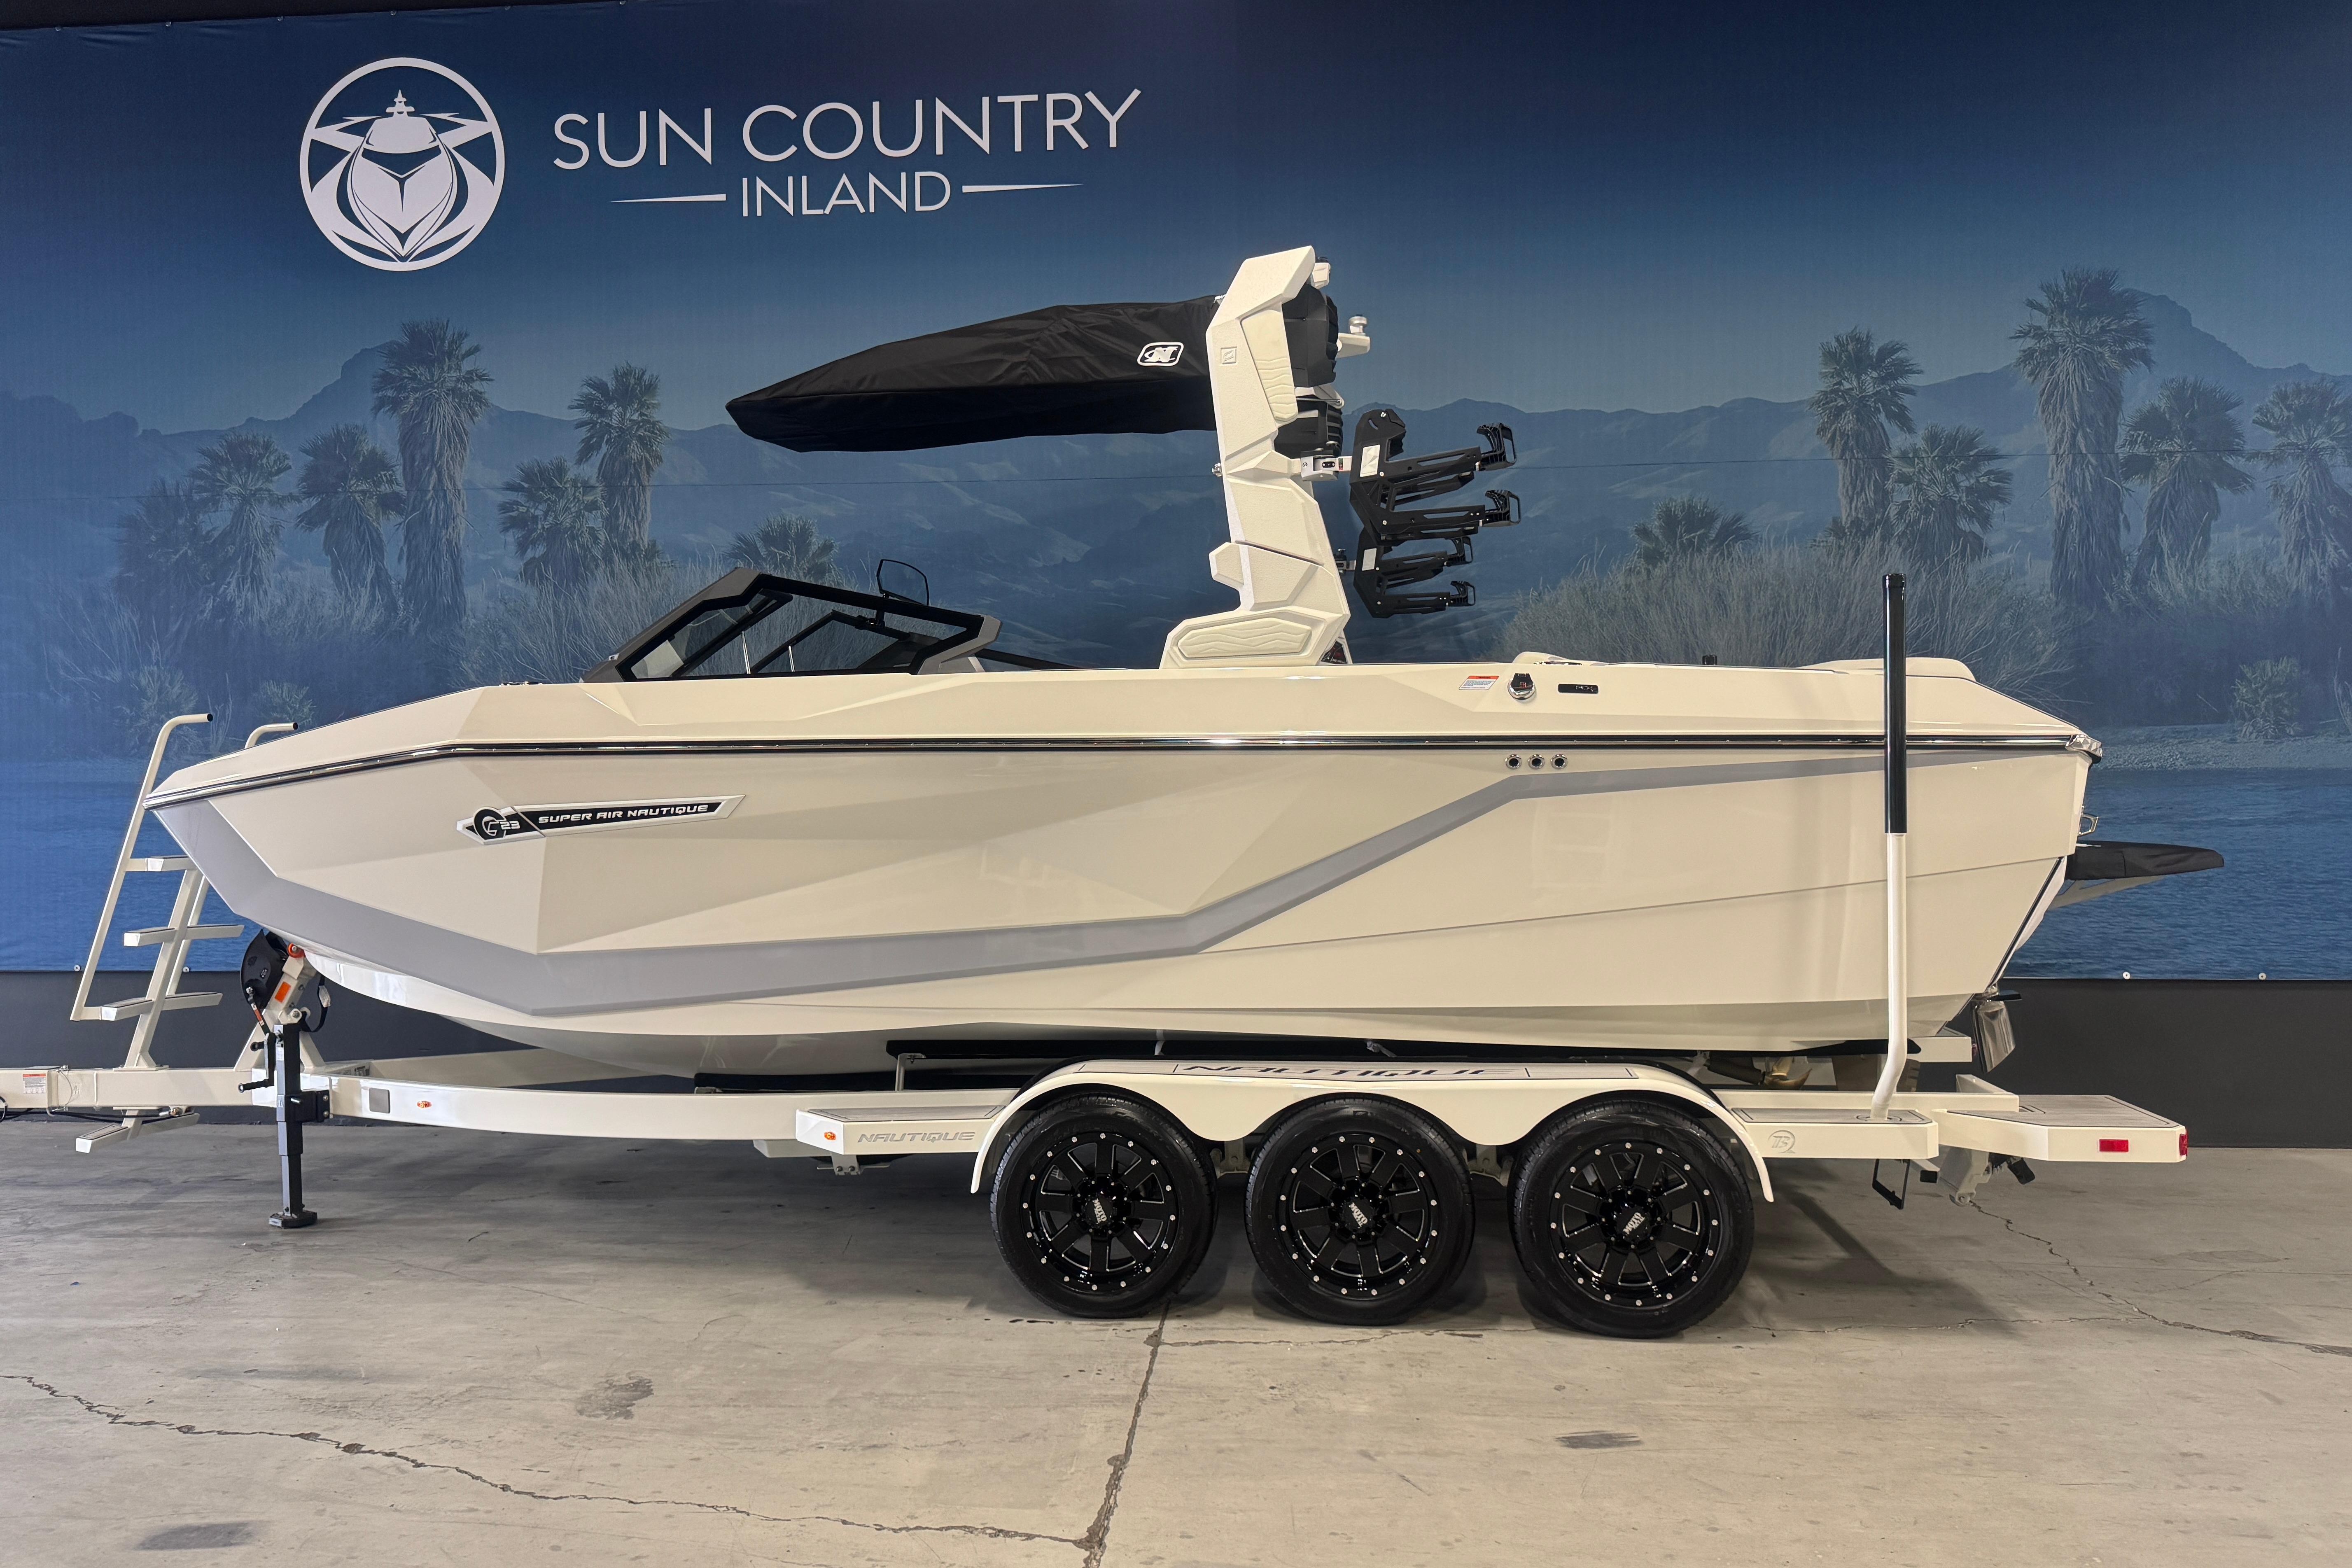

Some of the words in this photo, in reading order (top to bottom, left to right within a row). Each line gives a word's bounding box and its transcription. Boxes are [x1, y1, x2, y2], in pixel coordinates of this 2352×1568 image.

[553, 108, 712, 170] SUN
[742, 89, 1141, 162] COUNTRY
[742, 171, 951, 217] INLAND
[538, 813, 592, 823] SUPER
[627, 805, 709, 817] NAUTIQUE
[858, 1132, 975, 1143] NAUTIQUE
[1093, 1198, 1107, 1222] MOTO
[1349, 1202, 1367, 1224] MOTO
[1623, 1212, 1641, 1235] MOTO
